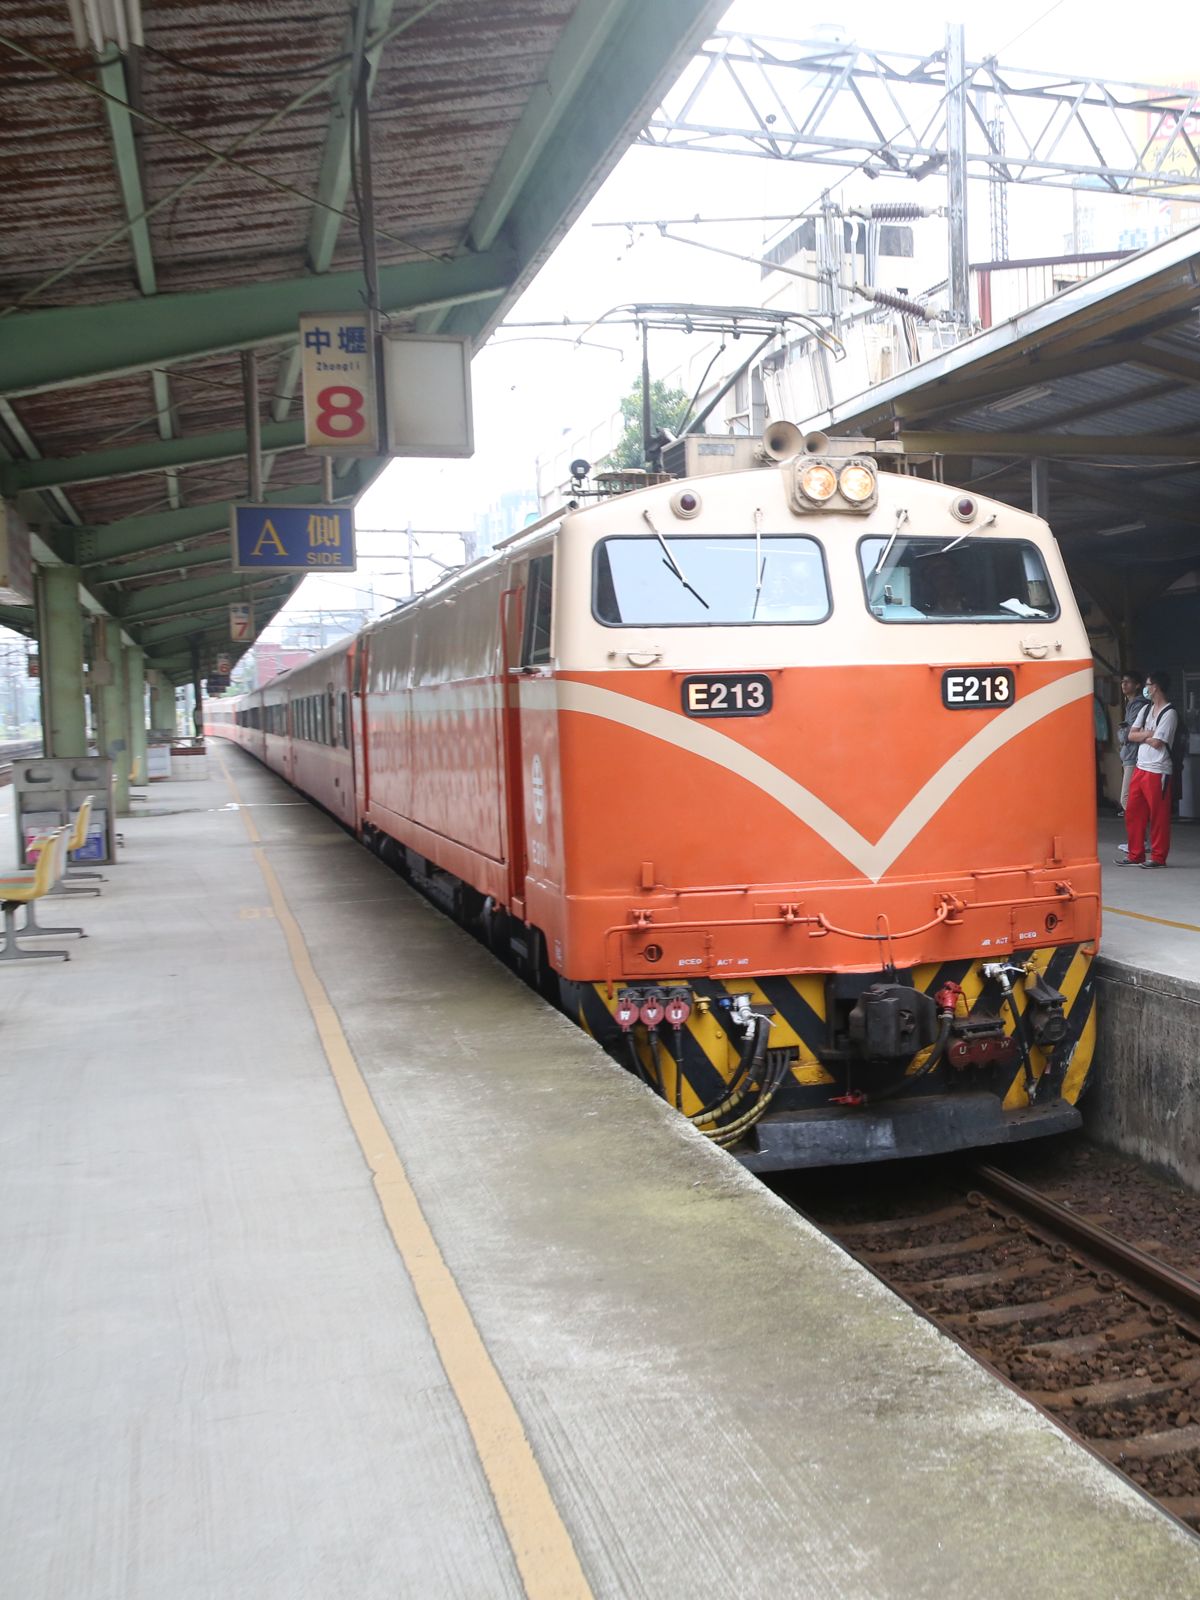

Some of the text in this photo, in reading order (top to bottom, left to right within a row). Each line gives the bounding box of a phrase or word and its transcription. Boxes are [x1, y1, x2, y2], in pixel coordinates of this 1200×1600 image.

[305, 327, 367, 355] 中壢
[316, 385, 366, 438] 8
[250, 514, 340, 556] A 側
[307, 552, 342, 565] SIDE
[235, 622, 250, 637] 7
[688, 682, 765, 710] E213
[947, 676, 1009, 702] E213
[647, 1009, 657, 1018] V
[671, 1010, 682, 1020] U
[960, 1046, 967, 1055] U
